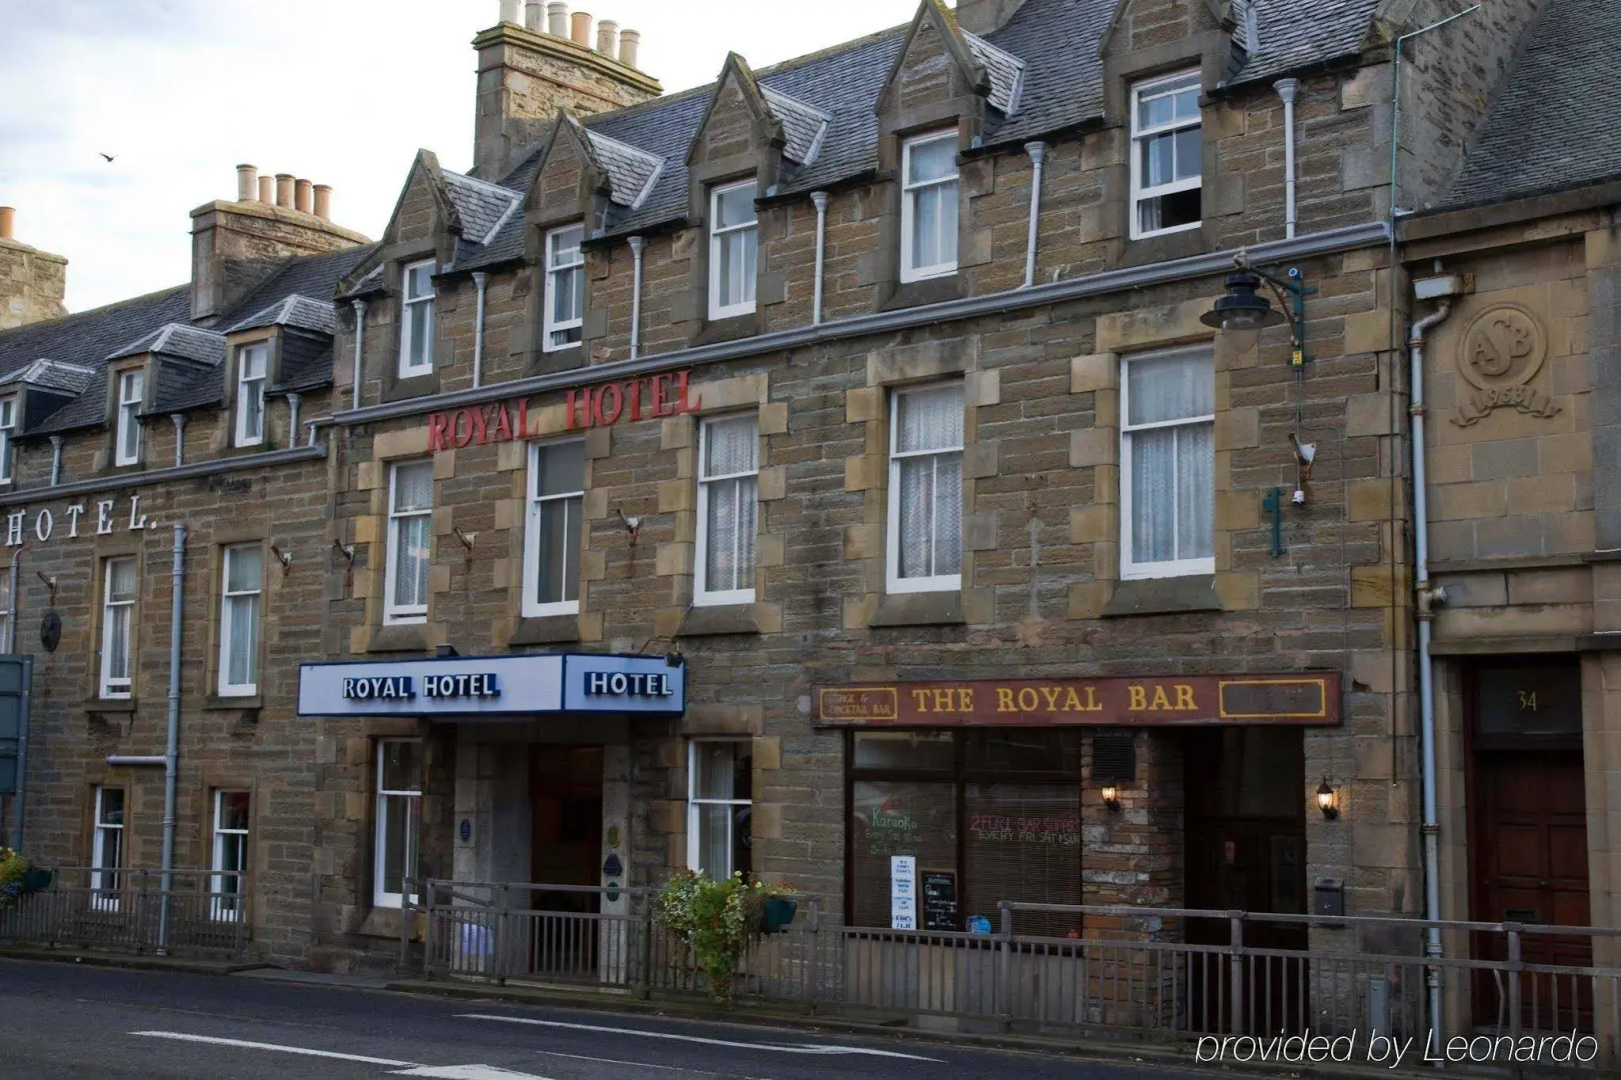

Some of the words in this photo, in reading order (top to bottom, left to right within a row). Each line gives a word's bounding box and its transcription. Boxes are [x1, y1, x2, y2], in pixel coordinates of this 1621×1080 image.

[427, 397, 539, 452] ROYAL
[566, 369, 702, 430] HOTEL
[5, 495, 157, 547] HOTEL.
[342, 677, 412, 698] ROYAL
[424, 674, 498, 697] HOTEL
[588, 671, 673, 696] HOTEL
[912, 688, 974, 712] THE
[996, 686, 1103, 712] ROYAL
[1128, 684, 1199, 711] BAR
[1517, 691, 1537, 711] 34
